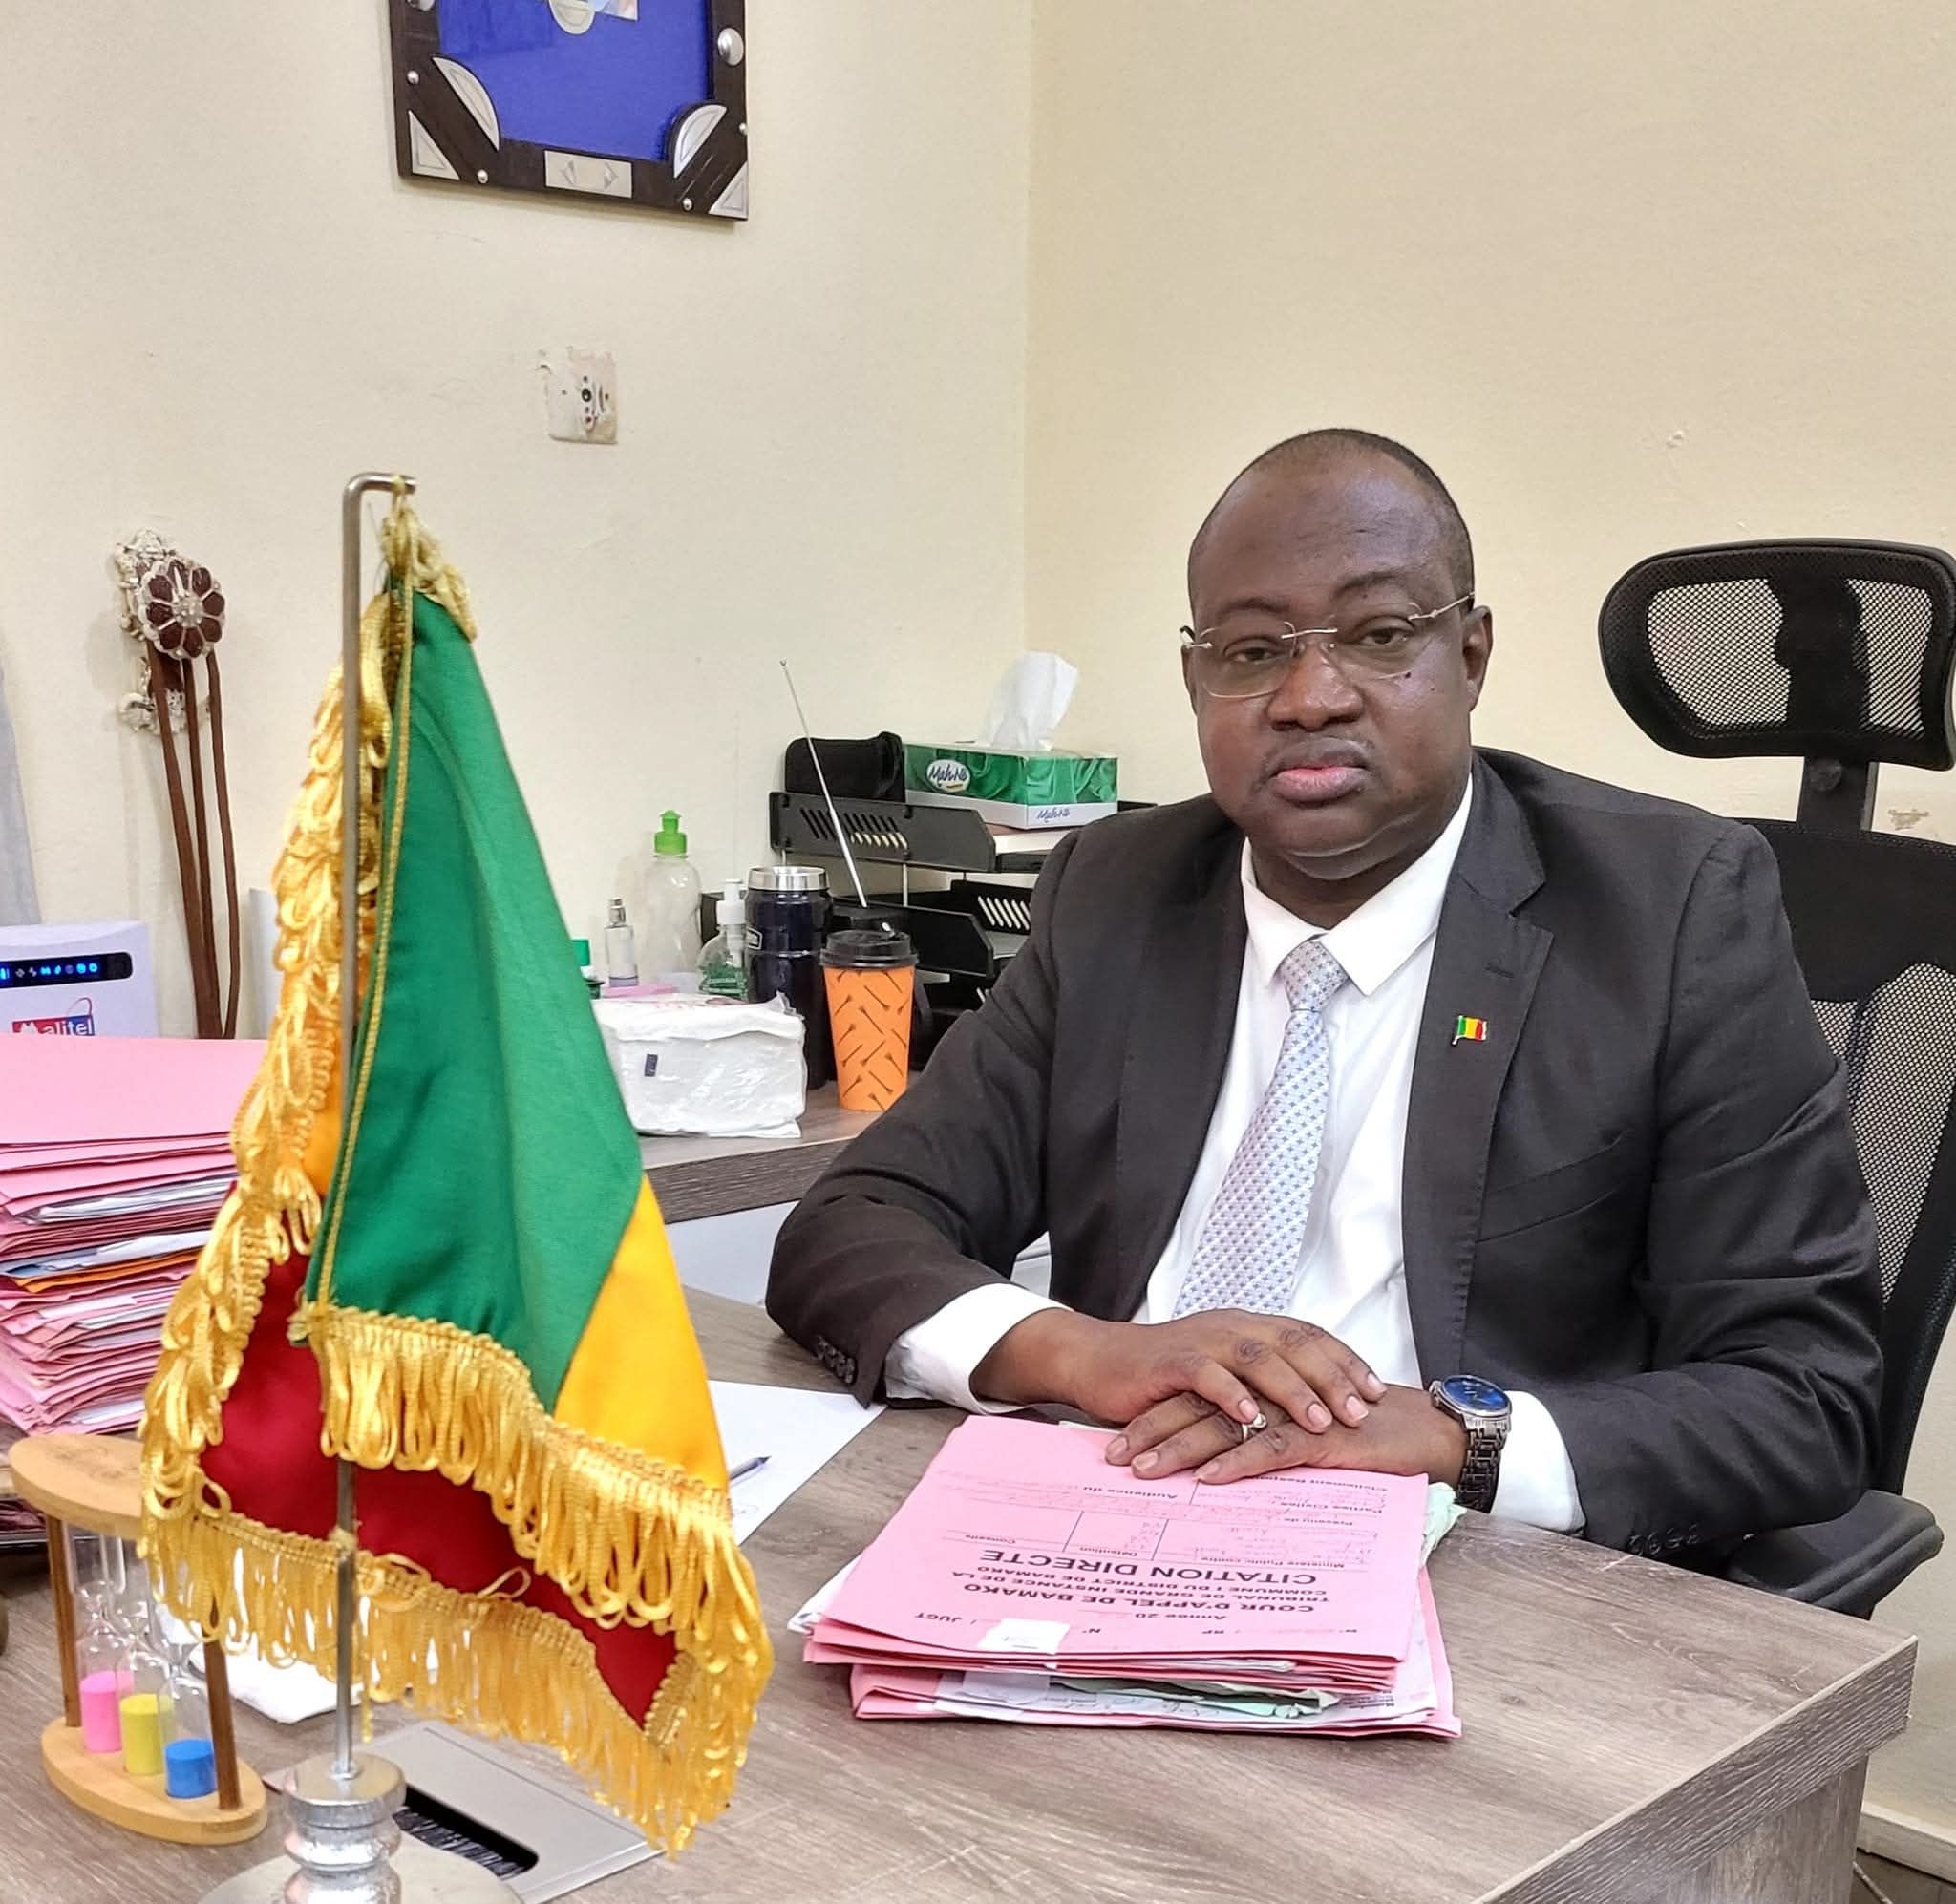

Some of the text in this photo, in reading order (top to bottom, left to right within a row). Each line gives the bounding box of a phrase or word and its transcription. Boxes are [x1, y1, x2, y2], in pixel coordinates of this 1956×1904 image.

[977, 1567, 1055, 1578] BAMAKO
[979, 1550, 1316, 1584] CITATION DIRECTE
[1010, 1578, 1107, 1592] INSTANCE
[1091, 1578, 1178, 1588] DISTRICT
[964, 1584, 1074, 1601] BAMAKO
[1115, 1589, 1193, 1597] GRANDE
[1081, 1596, 1115, 1604] DE
[1124, 1598, 1230, 1610] D'APPEL
[914, 1613, 962, 1622] JUGT
